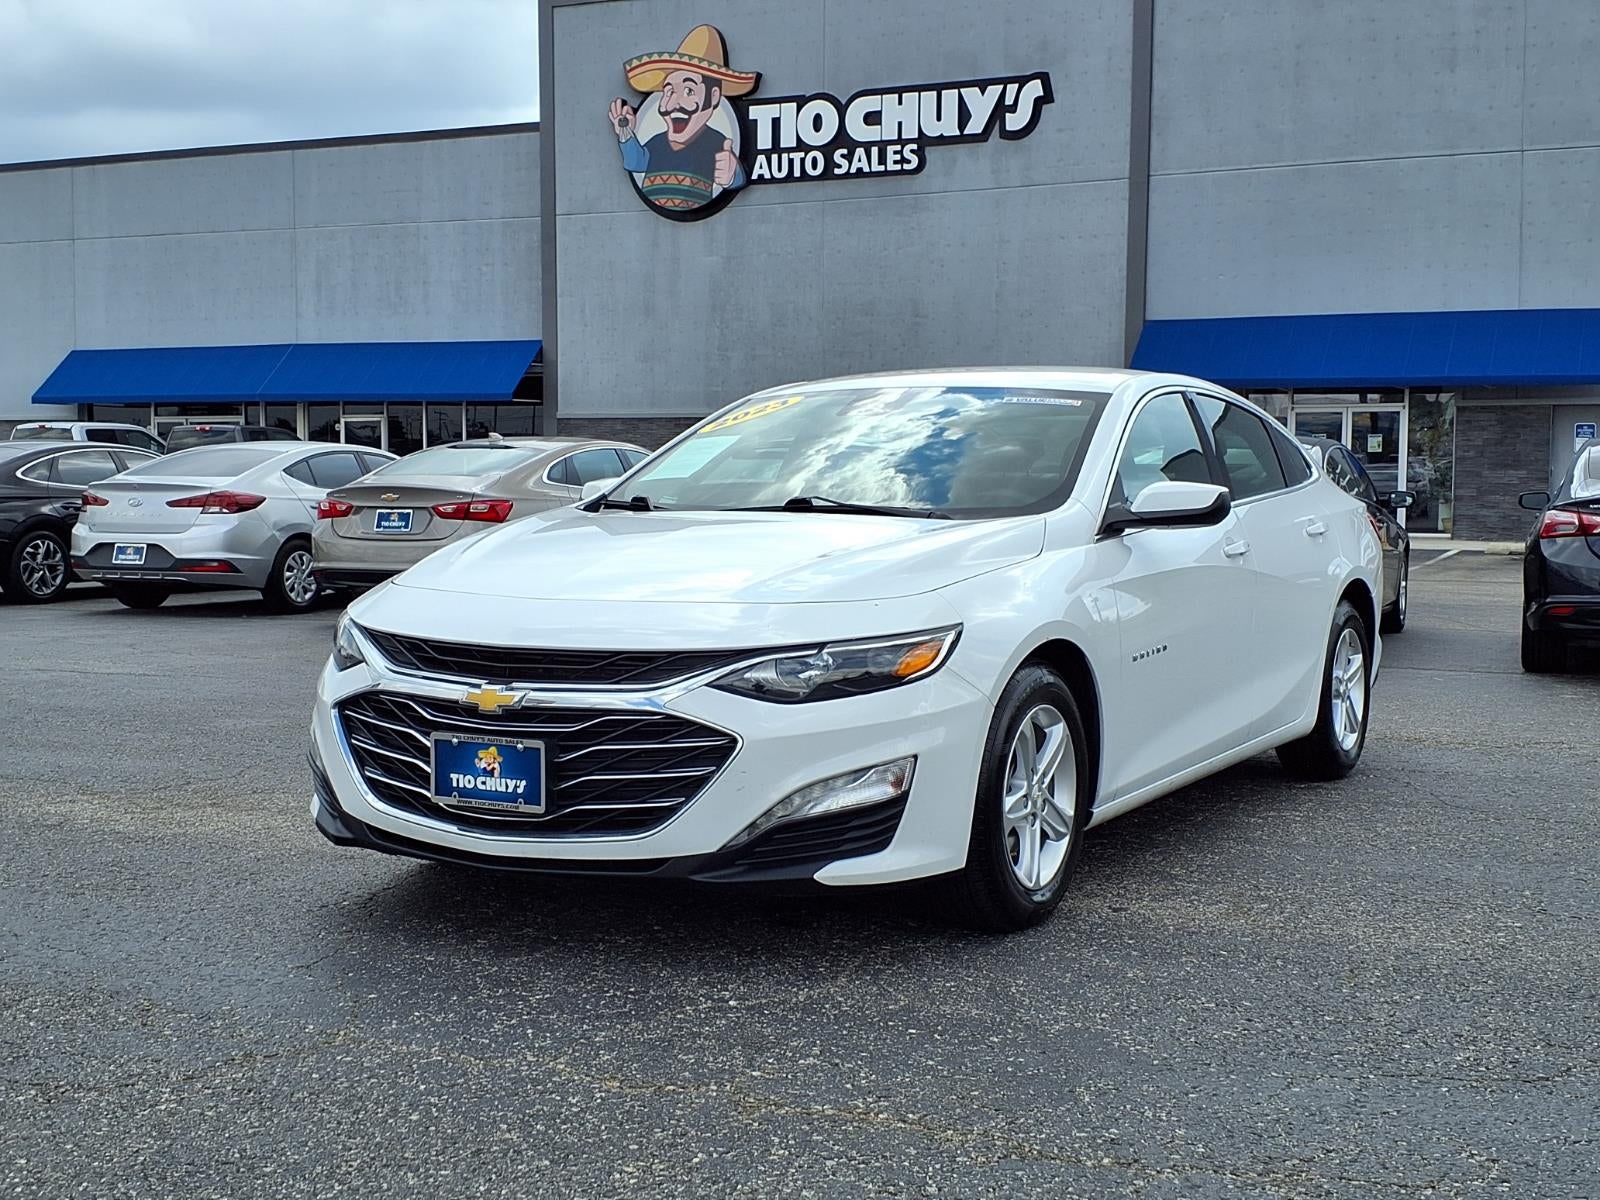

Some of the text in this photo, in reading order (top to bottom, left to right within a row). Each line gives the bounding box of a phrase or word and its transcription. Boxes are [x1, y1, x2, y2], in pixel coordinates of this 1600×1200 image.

[749, 79, 1044, 149] TIO CHUY'S
[751, 143, 919, 179] AUTO SALES
[449, 773, 527, 794] TIO CHUY'S
